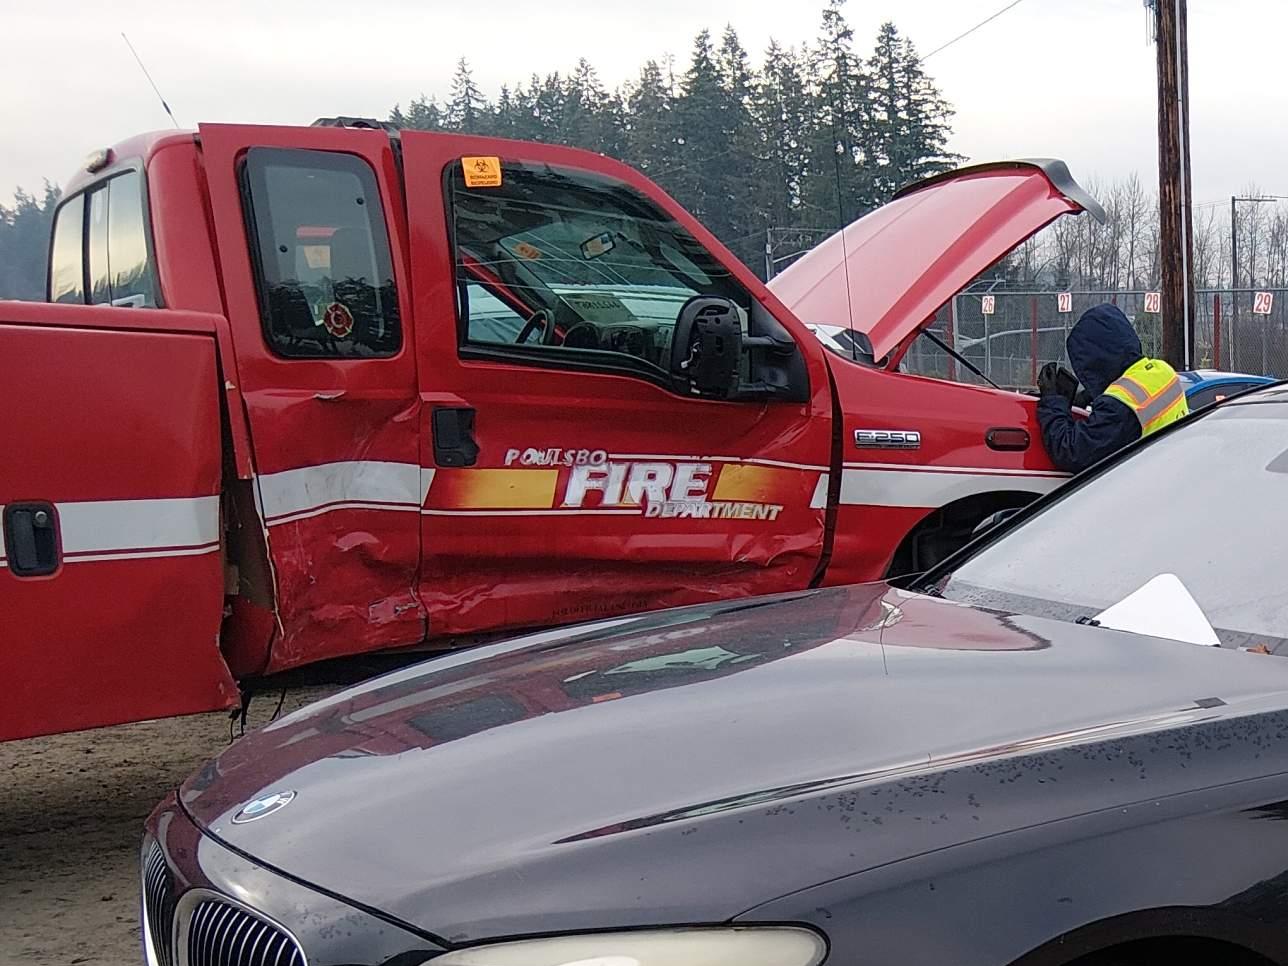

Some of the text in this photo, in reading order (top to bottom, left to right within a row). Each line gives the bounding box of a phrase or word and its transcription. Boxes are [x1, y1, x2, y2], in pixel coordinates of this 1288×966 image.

[983, 297, 994, 313] 26
[1060, 292, 1070, 311] 27
[1146, 293, 1159, 311] 28
[1255, 293, 1271, 312] 29
[561, 460, 712, 507] FIRE
[644, 500, 784, 521] DEPARTMENT
